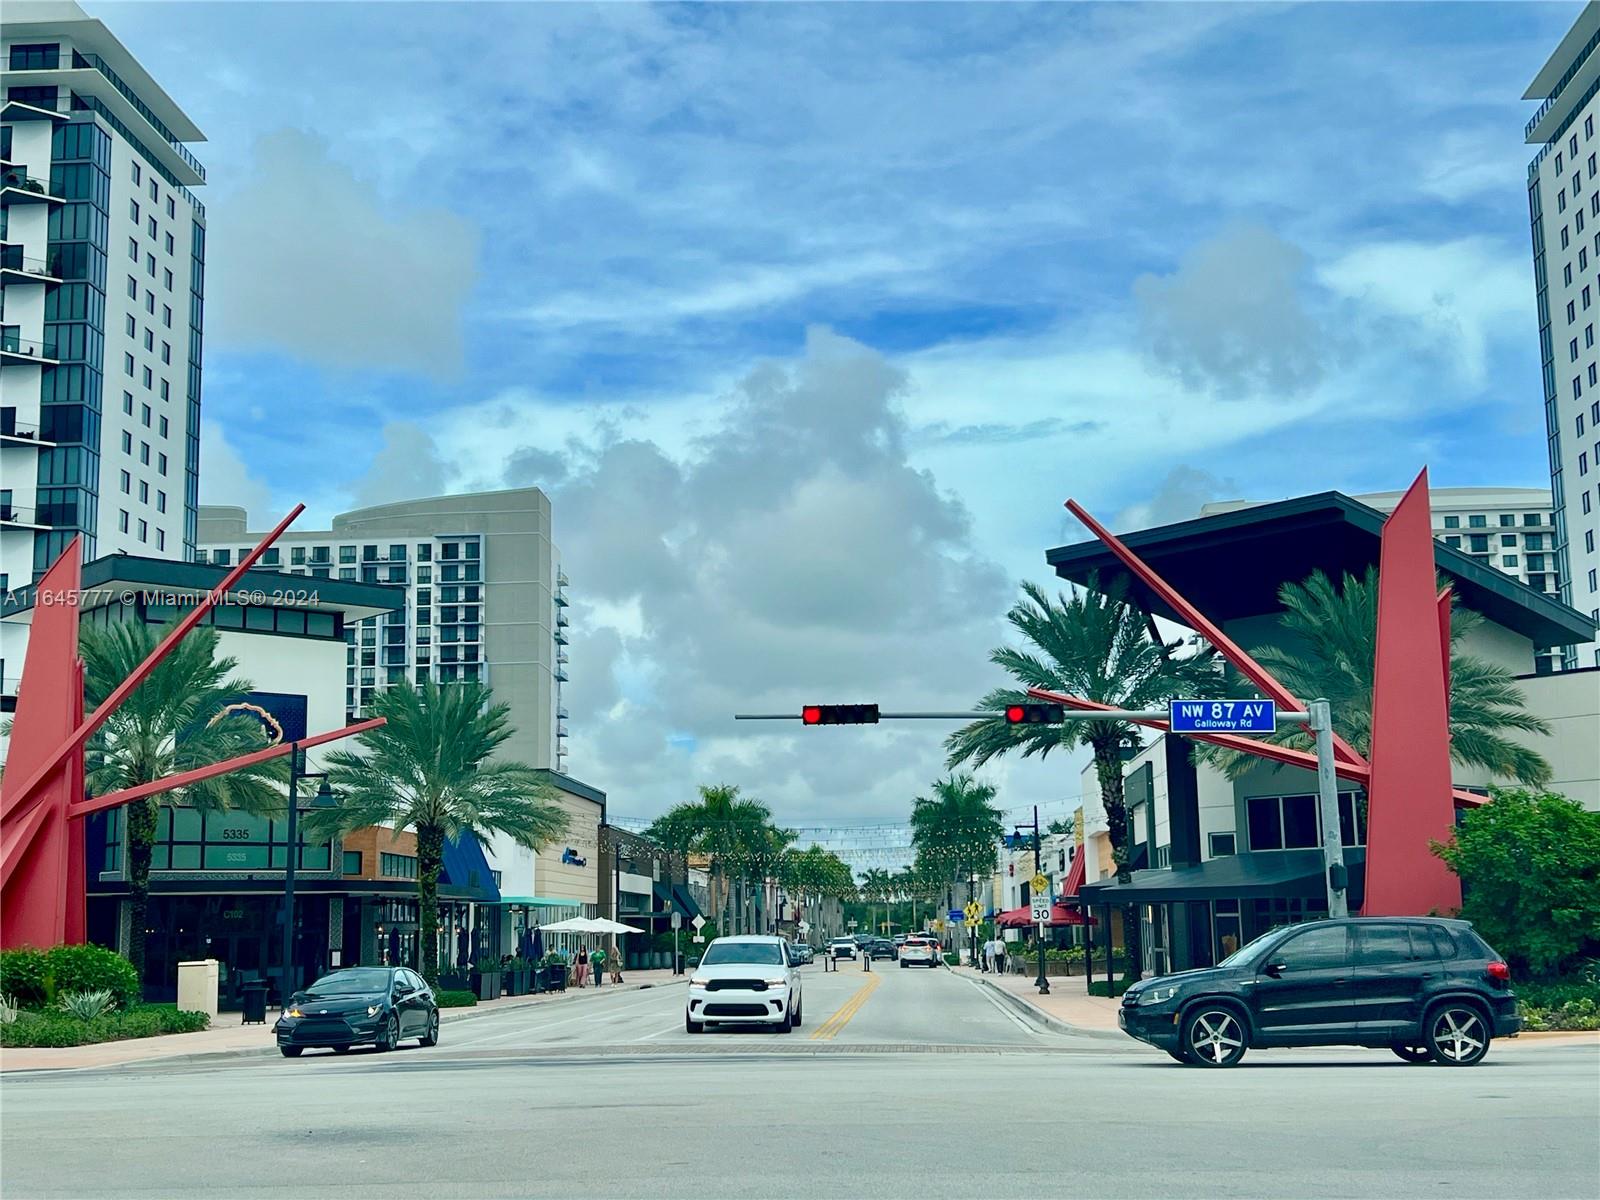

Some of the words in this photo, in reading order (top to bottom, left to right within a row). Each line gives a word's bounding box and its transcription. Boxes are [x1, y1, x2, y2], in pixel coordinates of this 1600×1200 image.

[1181, 704, 1204, 718] NW
[1211, 703, 1235, 719] 87
[1243, 704, 1263, 718] AV
[1194, 719, 1237, 729] Galloway
[1240, 719, 1252, 728] Rd
[223, 829, 250, 840] 5335
[1033, 909, 1049, 919] 30
